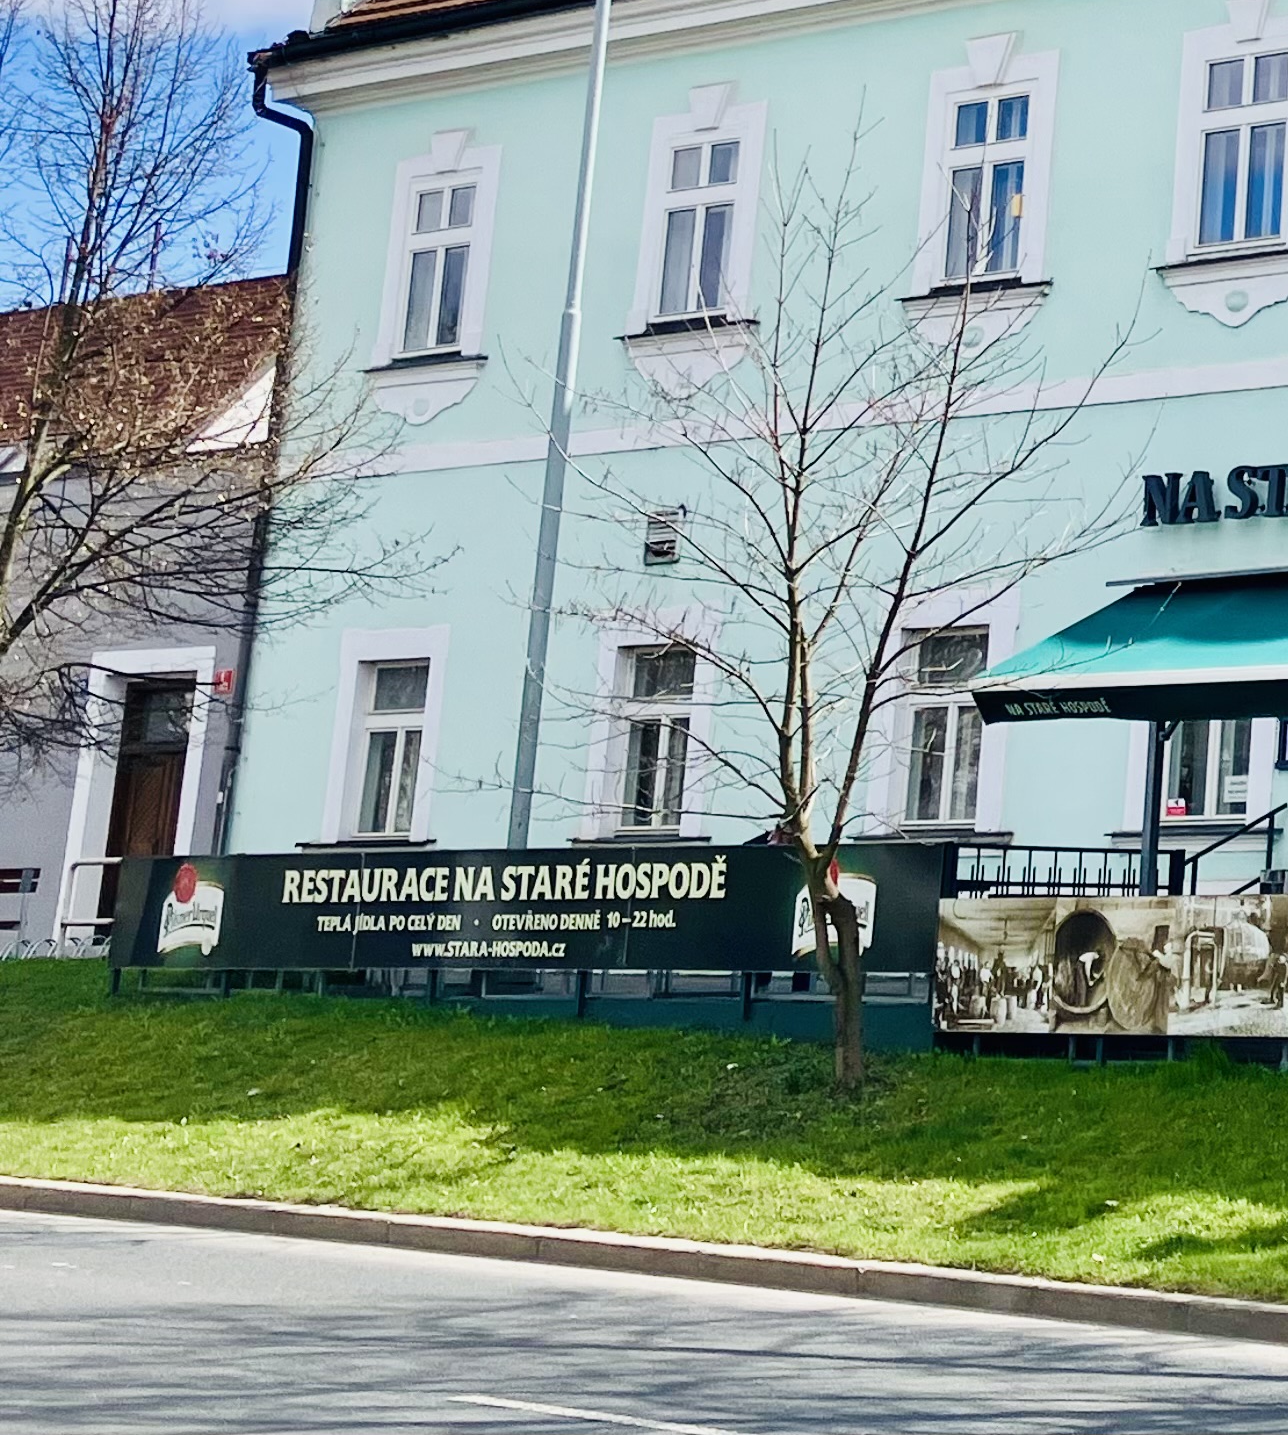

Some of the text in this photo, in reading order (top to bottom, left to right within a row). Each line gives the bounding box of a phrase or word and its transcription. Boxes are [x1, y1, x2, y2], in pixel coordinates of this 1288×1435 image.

[1141, 470, 1222, 527] NA
[1005, 703, 1025, 716] NA
[282, 854, 727, 903] RESTAURACE NA STARÉ HOSPODĚ
[317, 914, 351, 932] TEPLÁ
[352, 913, 386, 935] JÍDLA
[388, 915, 406, 931] PO
[407, 912, 434, 931] CELÝ
[436, 914, 461, 931] DEN
[492, 910, 558, 931] OTEVŘENO
[559, 909, 601, 930] DENNĚ
[649, 909, 676, 928] hod.
[411, 940, 566, 958] www.STARA-HOSPODA.cz
